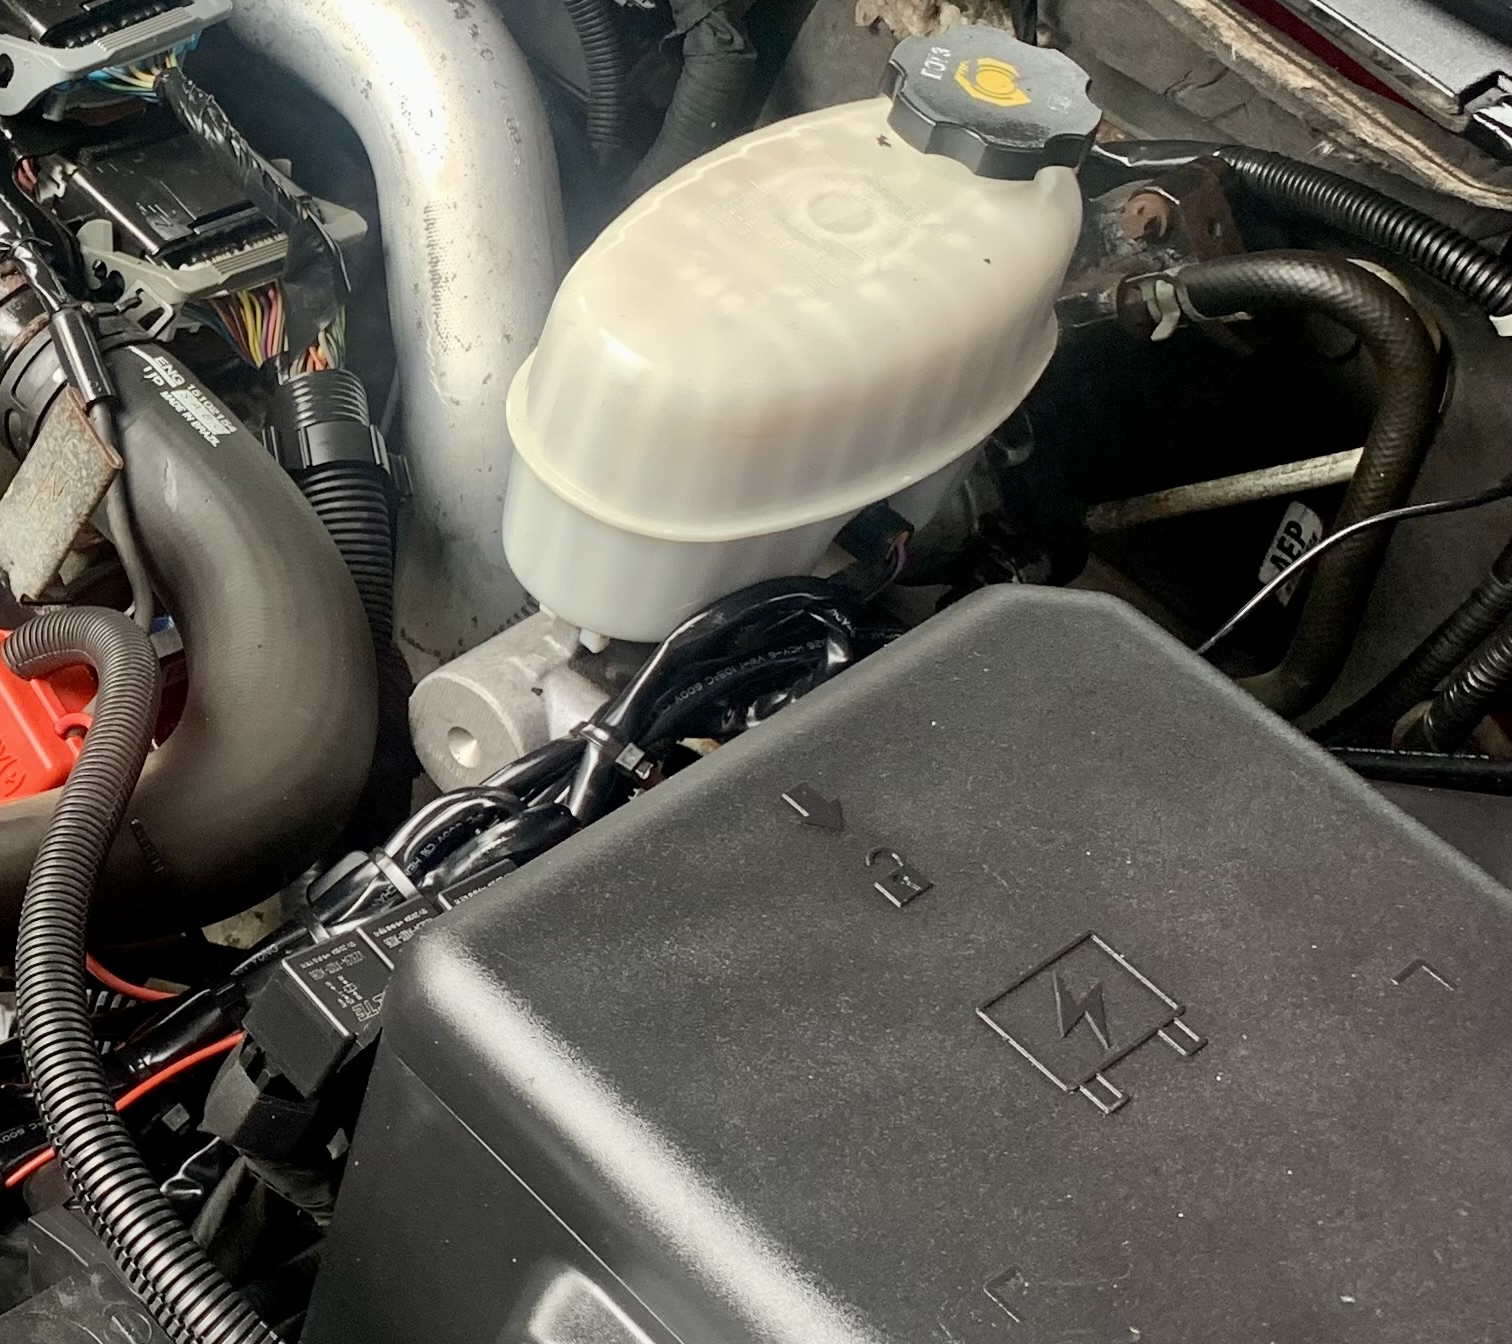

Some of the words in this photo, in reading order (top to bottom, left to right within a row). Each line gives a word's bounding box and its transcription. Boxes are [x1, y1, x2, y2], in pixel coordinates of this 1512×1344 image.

[155, 355, 185, 386] ENG
[160, 390, 186, 413] MADE
[181, 410, 195, 422] IN
[191, 419, 220, 447] BRAZIL
